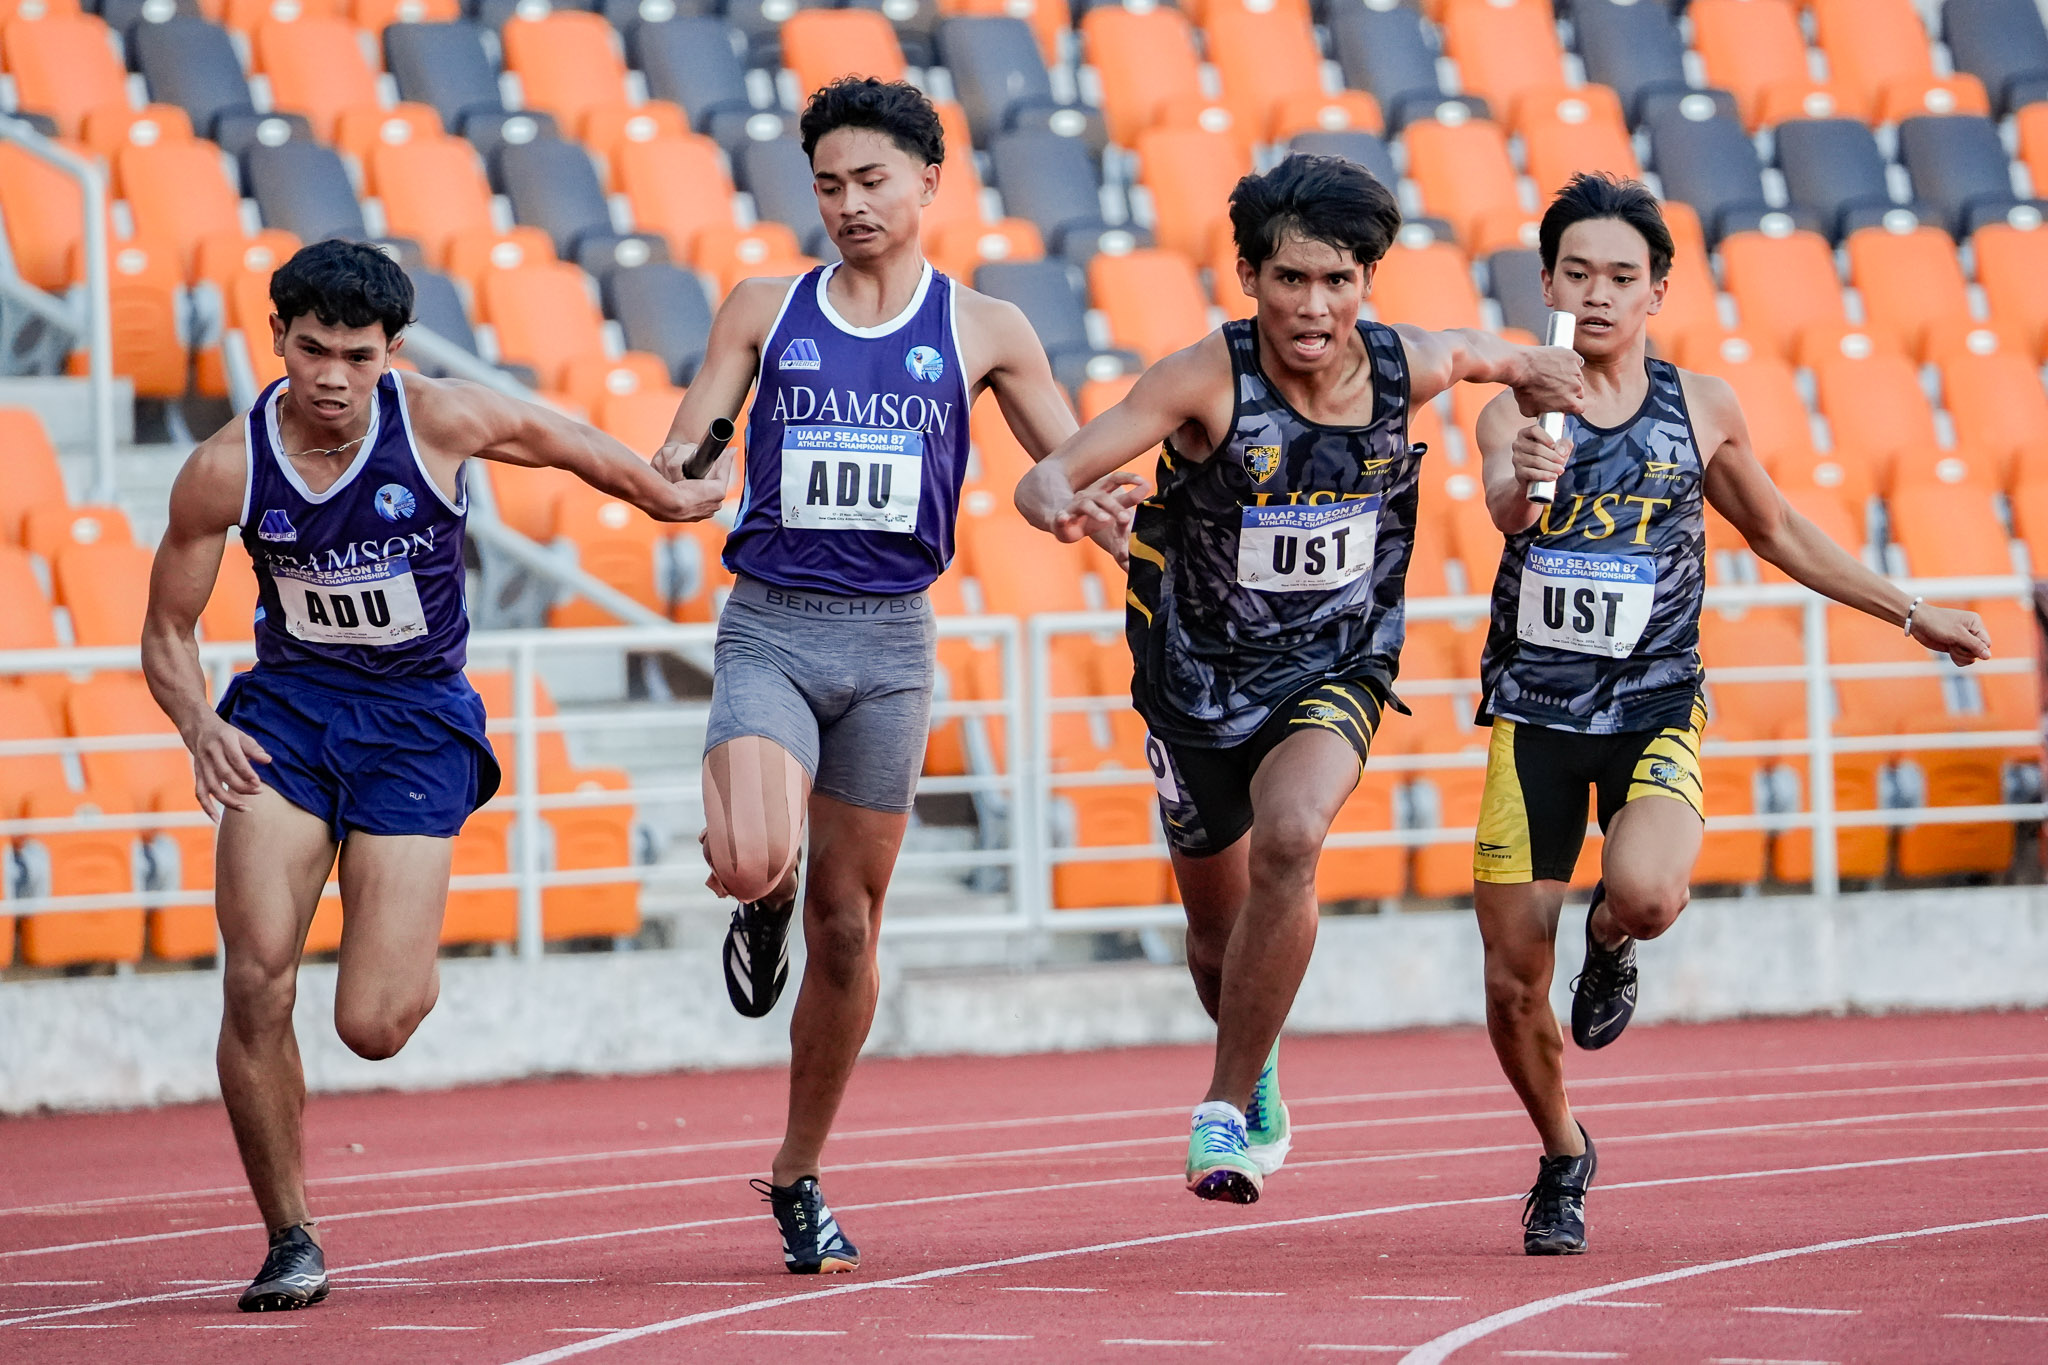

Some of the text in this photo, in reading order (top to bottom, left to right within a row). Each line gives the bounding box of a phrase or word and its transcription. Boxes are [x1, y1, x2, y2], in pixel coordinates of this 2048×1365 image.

[771, 386, 953, 437] ADAMSON
[797, 431, 907, 445] UAAP SEASON 87
[797, 440, 904, 453] ATHLETICS CHAMPIONSHIPS
[806, 460, 893, 509] ADU
[1258, 501, 1367, 522] UAAP SEASON 87
[1259, 508, 1362, 529] ATHLETICS CHAMPIONSHIPS
[1539, 493, 1672, 546] UST
[265, 525, 435, 573] AMSON
[1272, 527, 1350, 576] UST
[316, 564, 372, 580] SEASON
[374, 562, 390, 573] 87
[1530, 553, 1639, 573] UAAP SEASON 87
[1531, 563, 1637, 581] ATHLETICS CHAMPIONSHIPS
[324, 571, 391, 585] CHAMPIONSHIPS
[304, 589, 391, 629] ADU
[765, 589, 929, 616] BENCH/BO
[1543, 585, 1624, 638] UST
